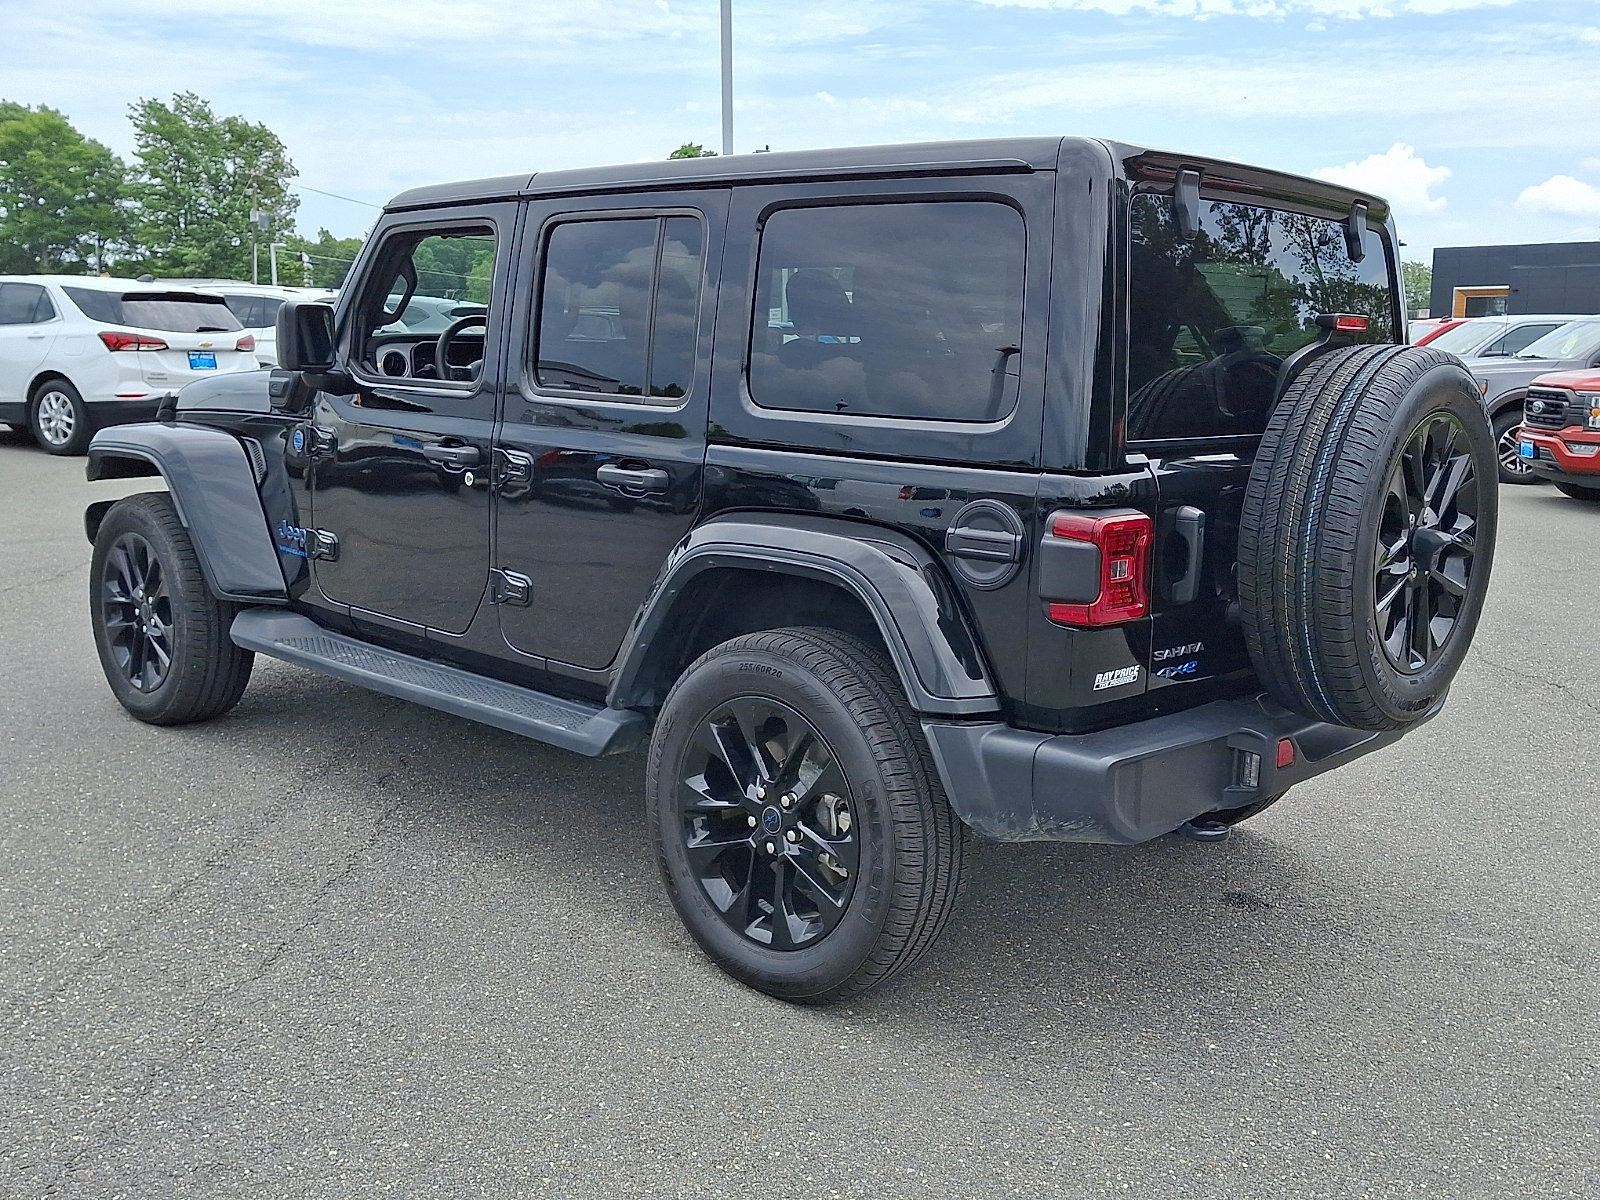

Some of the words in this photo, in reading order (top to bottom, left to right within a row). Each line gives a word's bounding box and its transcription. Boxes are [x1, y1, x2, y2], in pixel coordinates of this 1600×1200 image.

[278, 519, 306, 548] Jeep
[1153, 642, 1204, 661] SAHARA
[739, 662, 783, 679] 255/60R20
[1095, 671, 1115, 684] RAY
[1114, 664, 1141, 679] PRICE
